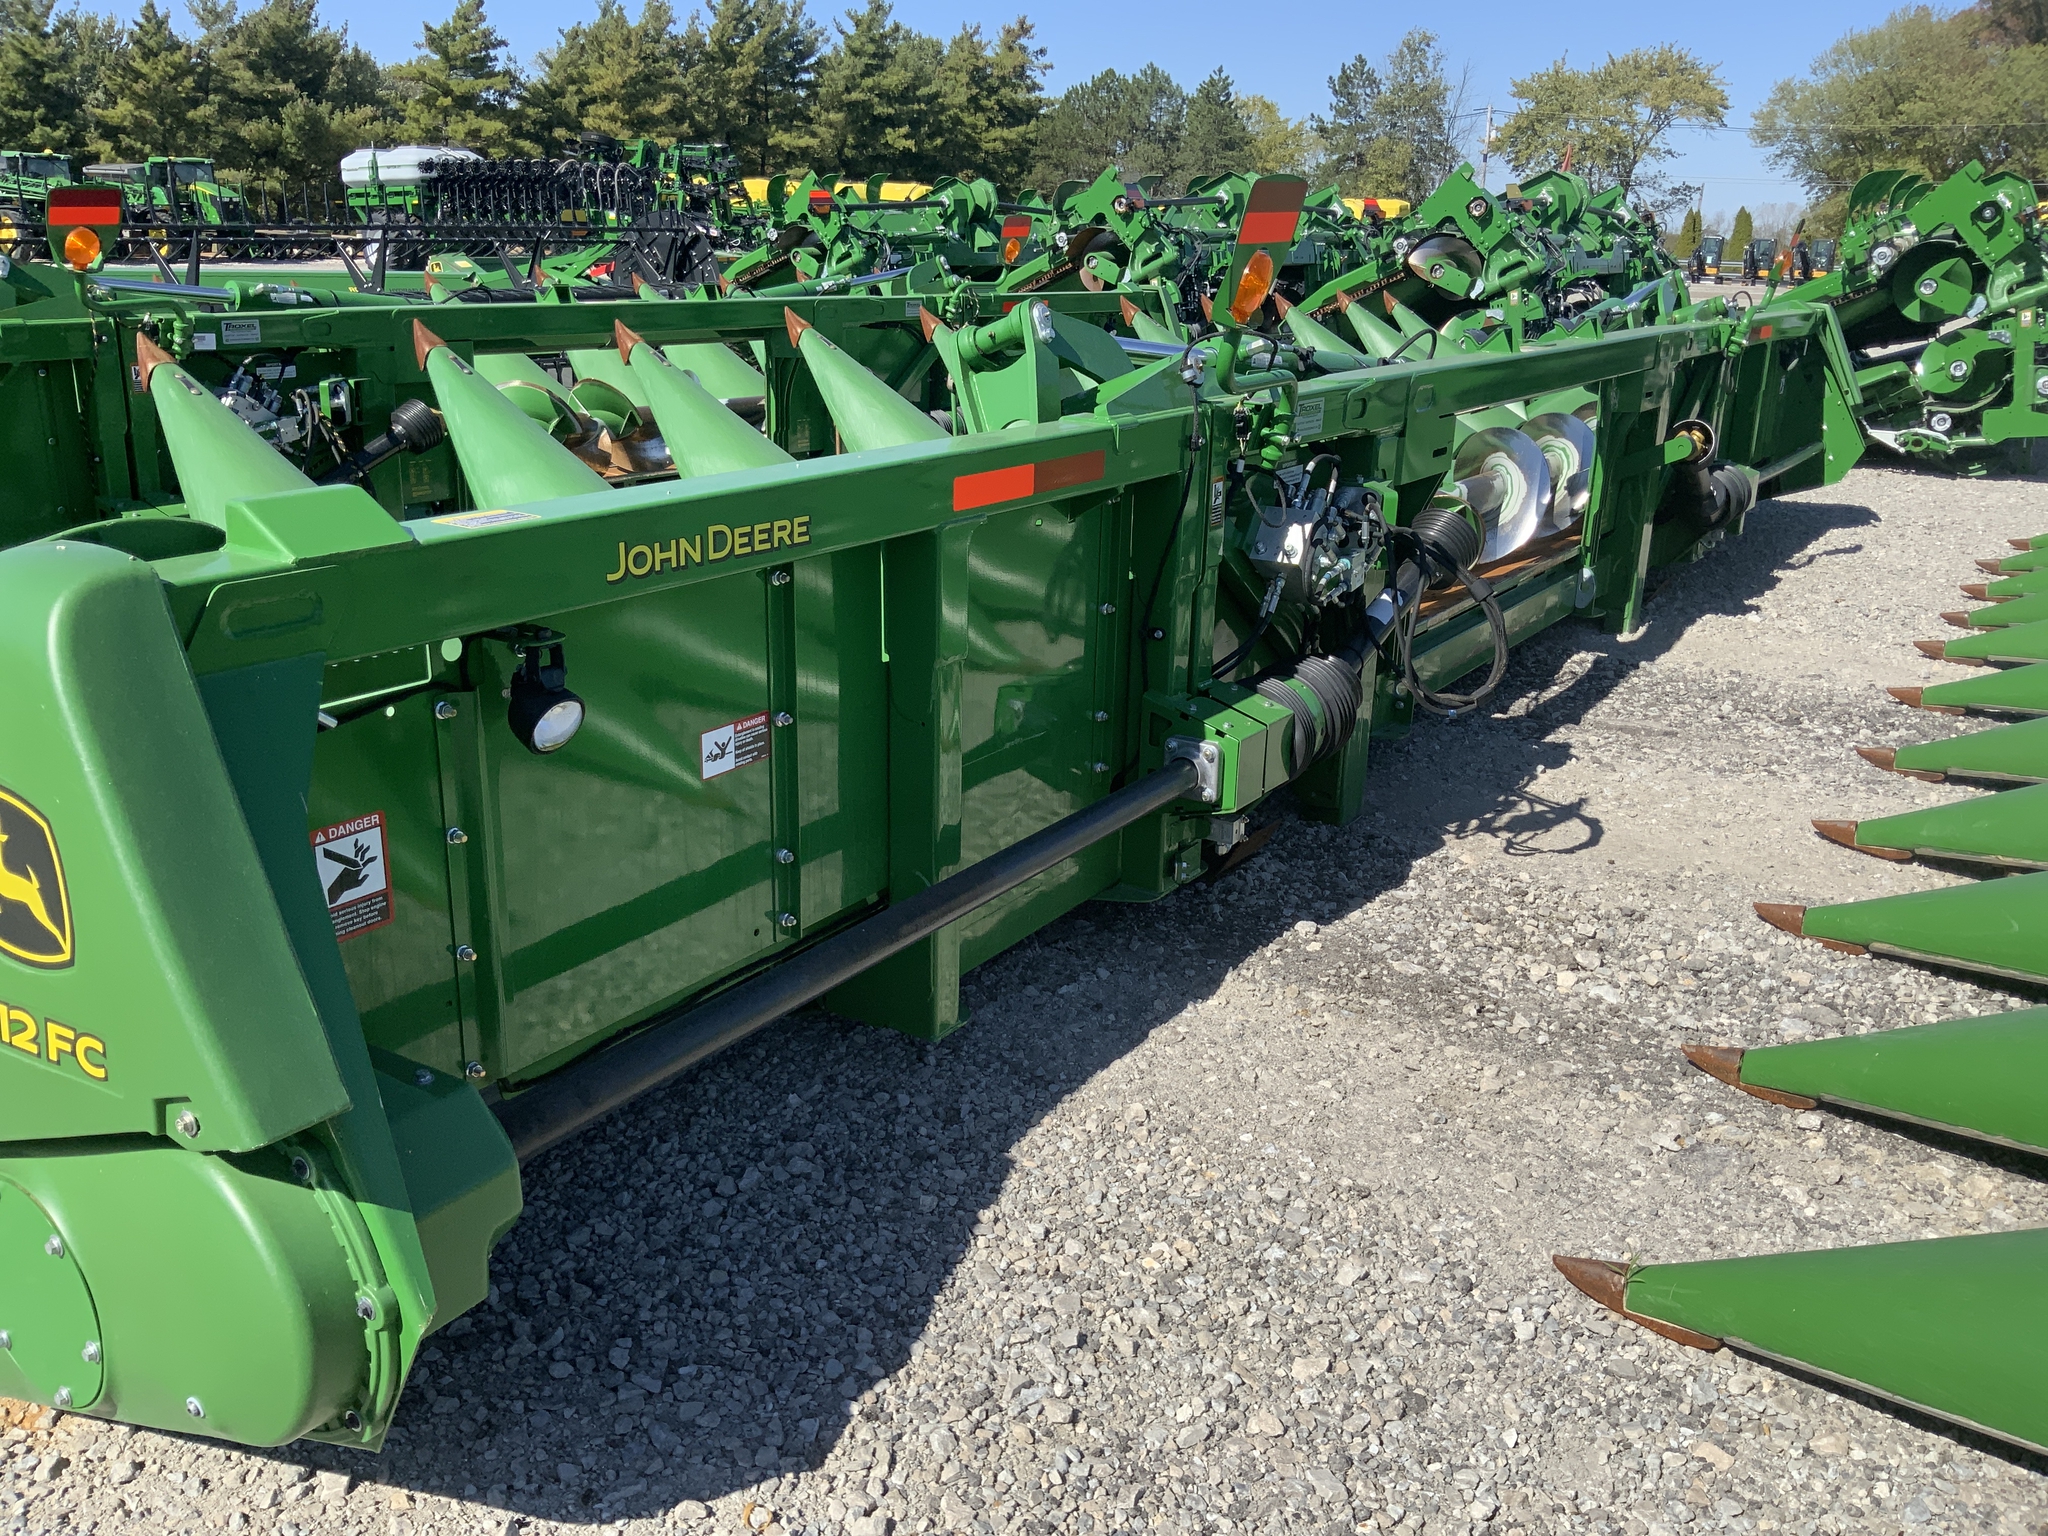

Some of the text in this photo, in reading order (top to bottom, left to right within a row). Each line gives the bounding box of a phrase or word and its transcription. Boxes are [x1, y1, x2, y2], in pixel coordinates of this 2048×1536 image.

[606, 515, 811, 583] JOHN DEERE
[742, 716, 766, 729] DANGER
[328, 814, 380, 839] DANGER
